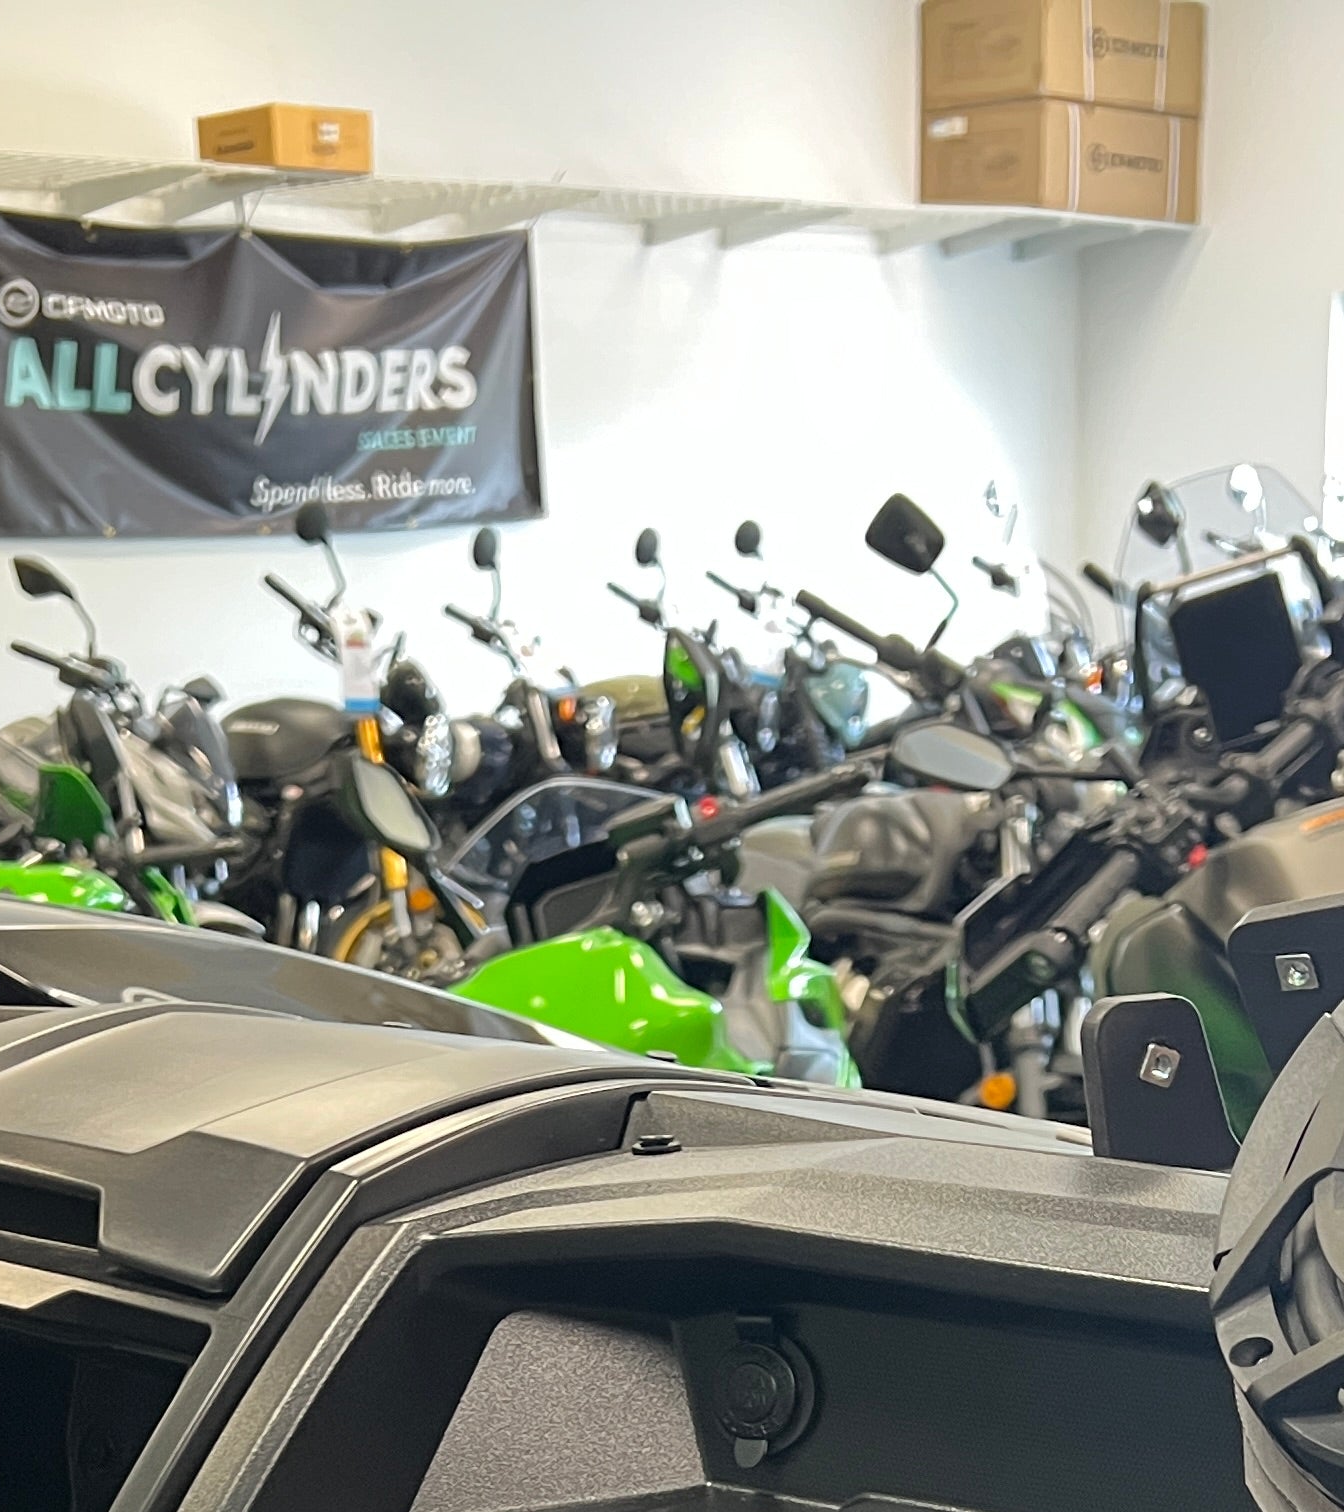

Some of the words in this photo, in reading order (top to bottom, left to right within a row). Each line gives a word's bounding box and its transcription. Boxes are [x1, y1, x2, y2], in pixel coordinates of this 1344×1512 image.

[4, 337, 133, 412] ALL
[372, 468, 424, 500] Ride
[428, 473, 477, 496] more.
